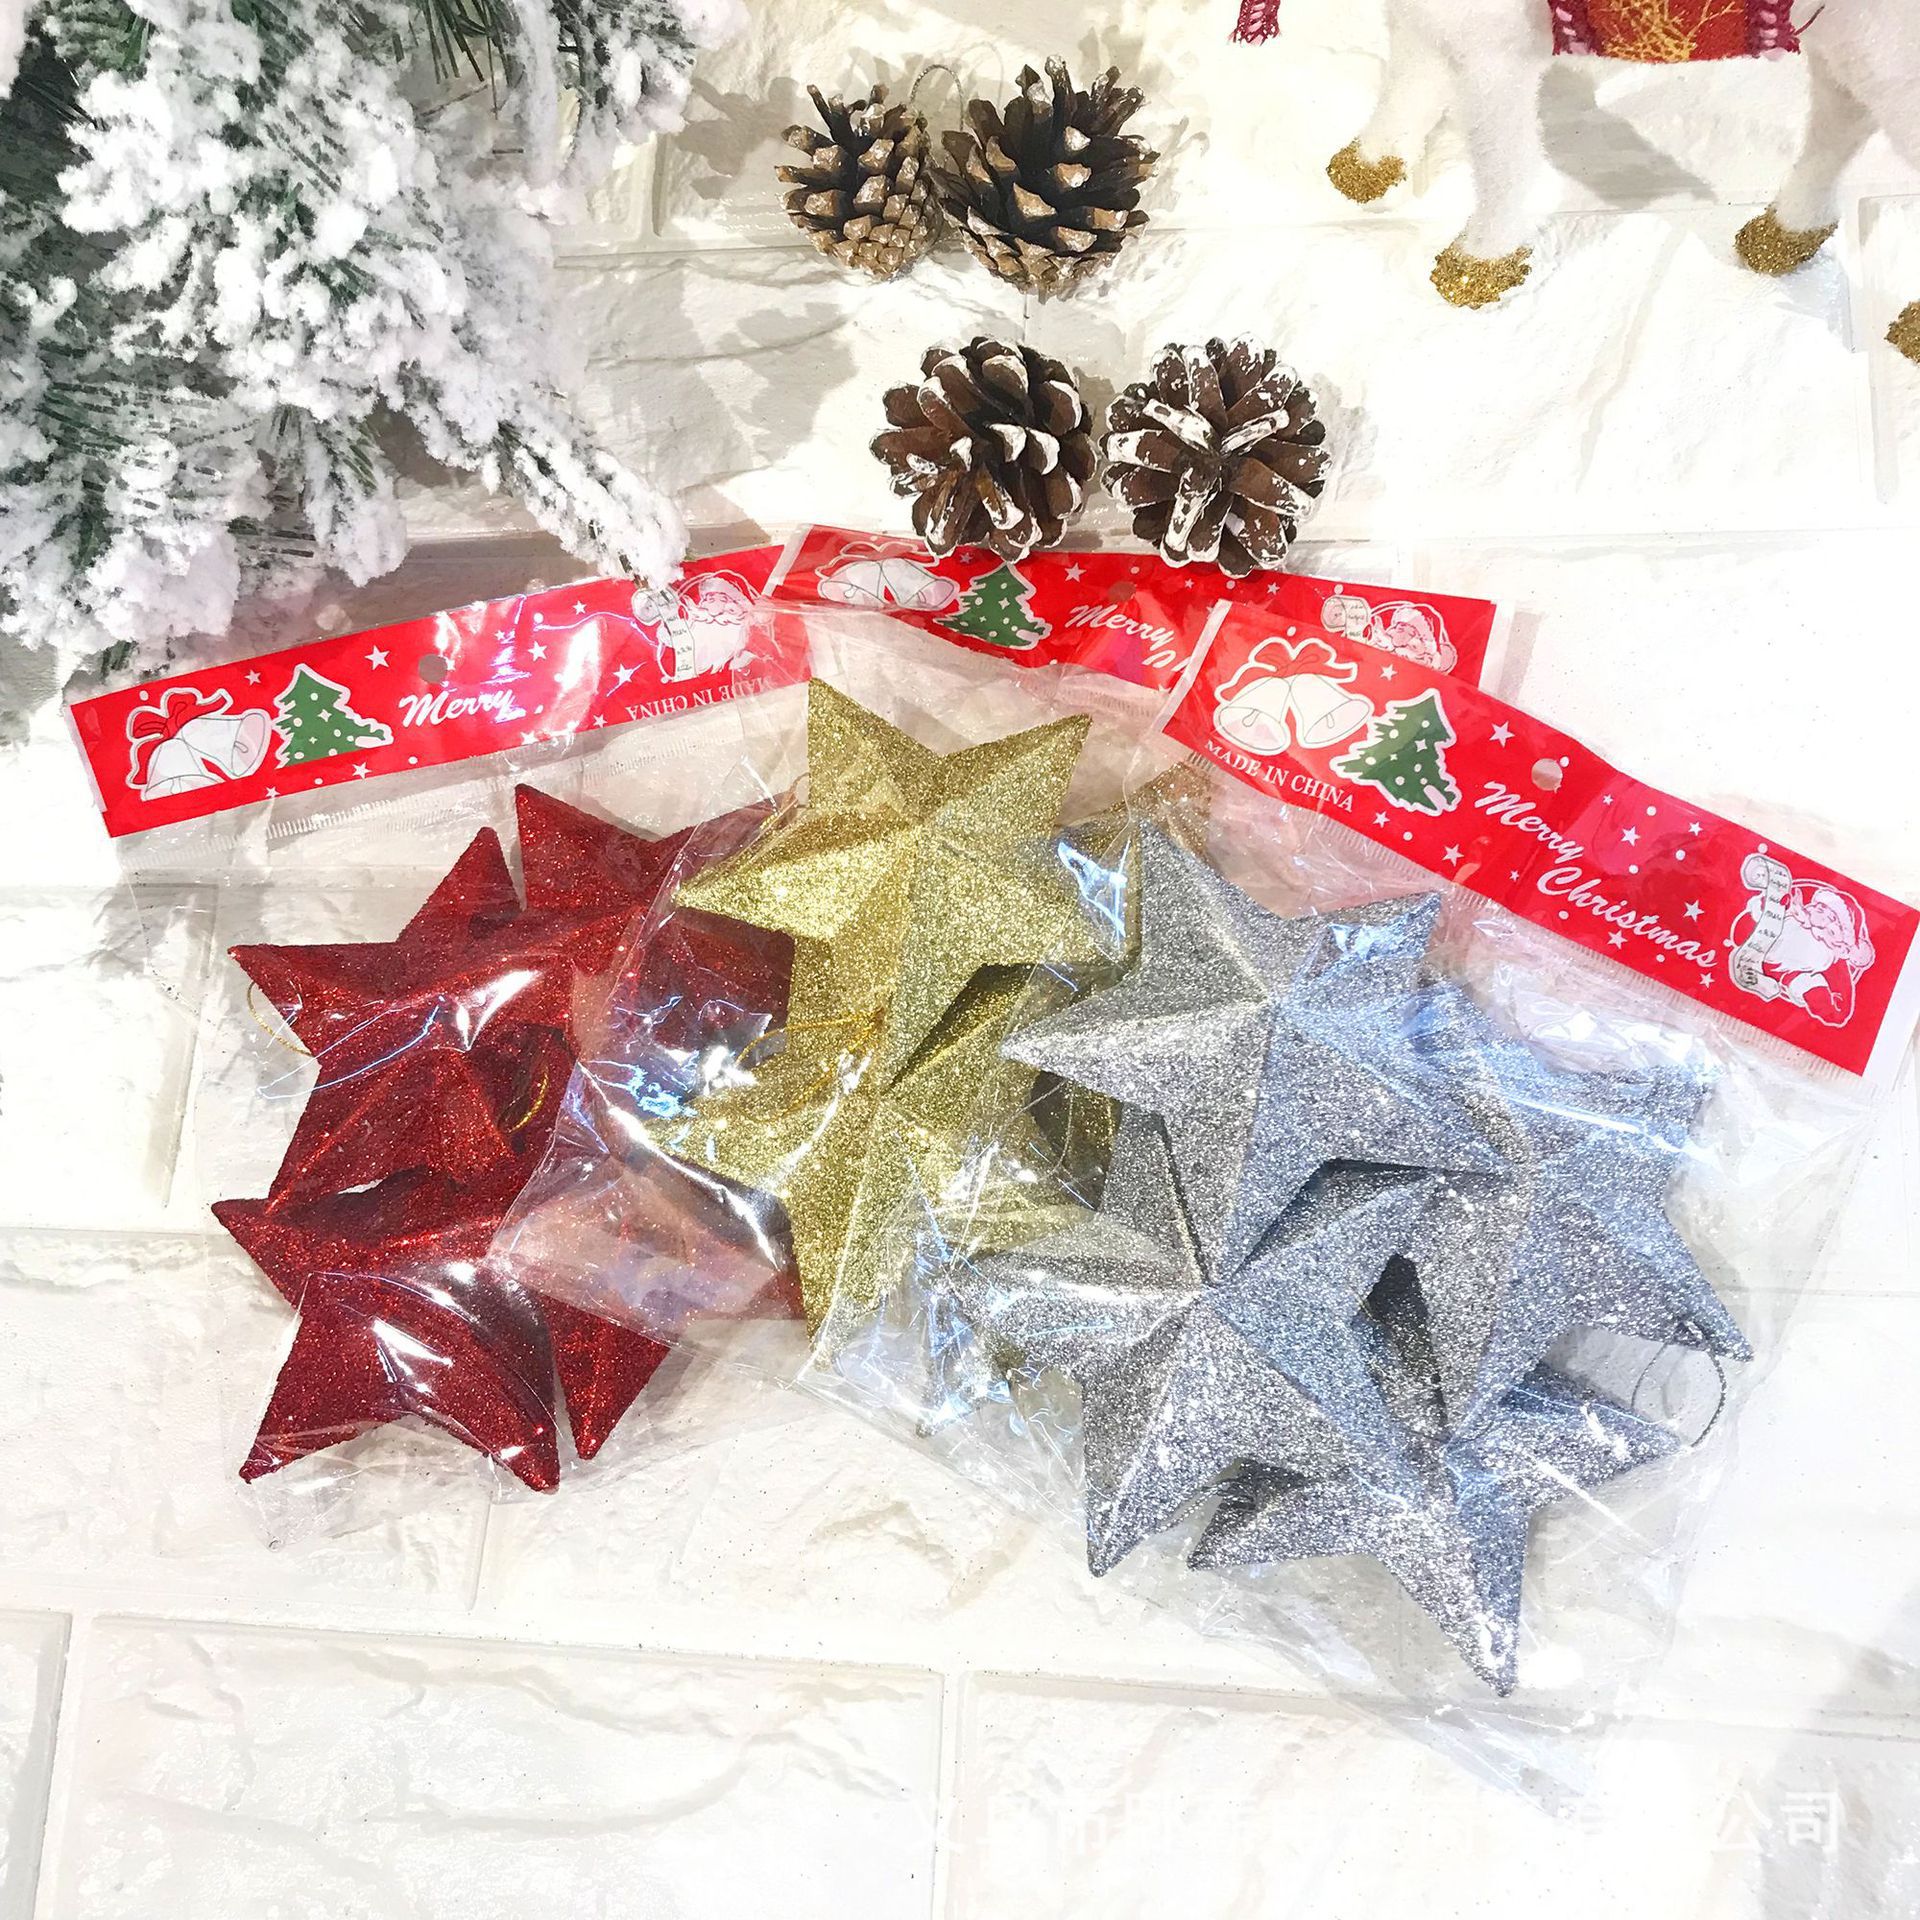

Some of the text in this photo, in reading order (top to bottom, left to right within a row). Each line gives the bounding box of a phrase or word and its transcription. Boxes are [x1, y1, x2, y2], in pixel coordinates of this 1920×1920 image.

[1065, 603, 1175, 650] Merry
[398, 689, 518, 728] Merry
[625, 694, 688, 721] CHINA
[692, 688, 714, 706] IN
[1204, 739, 1355, 813] MADE IN CHINA
[1474, 781, 1583, 863] Merry
[1537, 868, 1718, 969] Christmas
